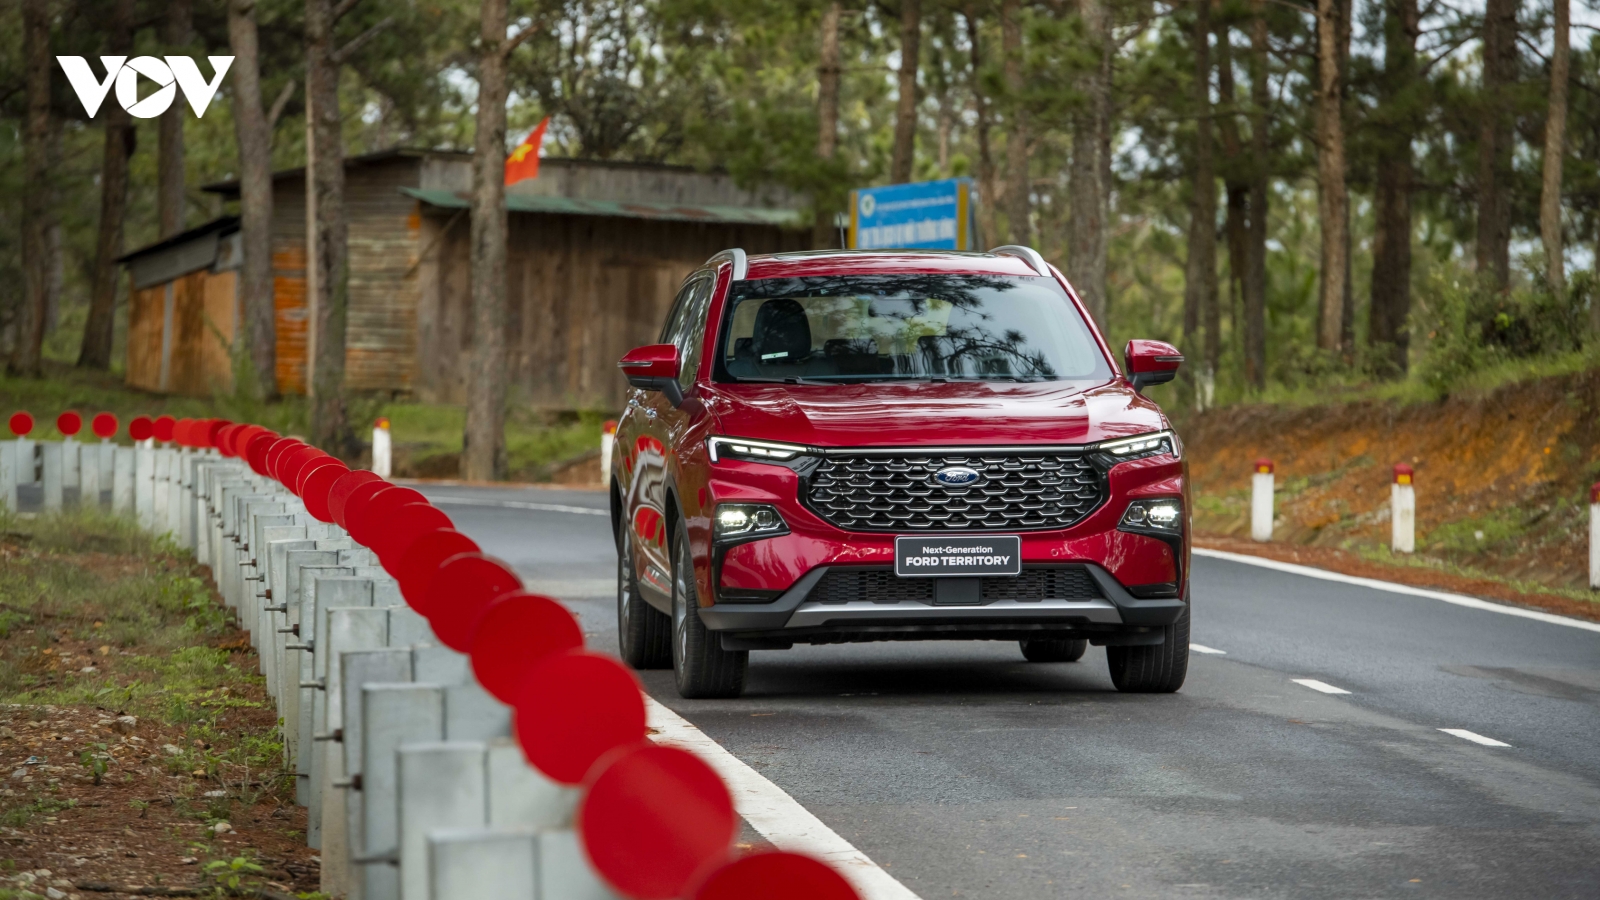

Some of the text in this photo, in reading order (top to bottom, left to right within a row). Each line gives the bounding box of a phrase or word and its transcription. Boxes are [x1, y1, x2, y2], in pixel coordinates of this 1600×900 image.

[945, 471, 970, 482] Ford
[922, 546, 993, 554] Next-Generation
[905, 555, 1011, 567] FORD TERRITORY
